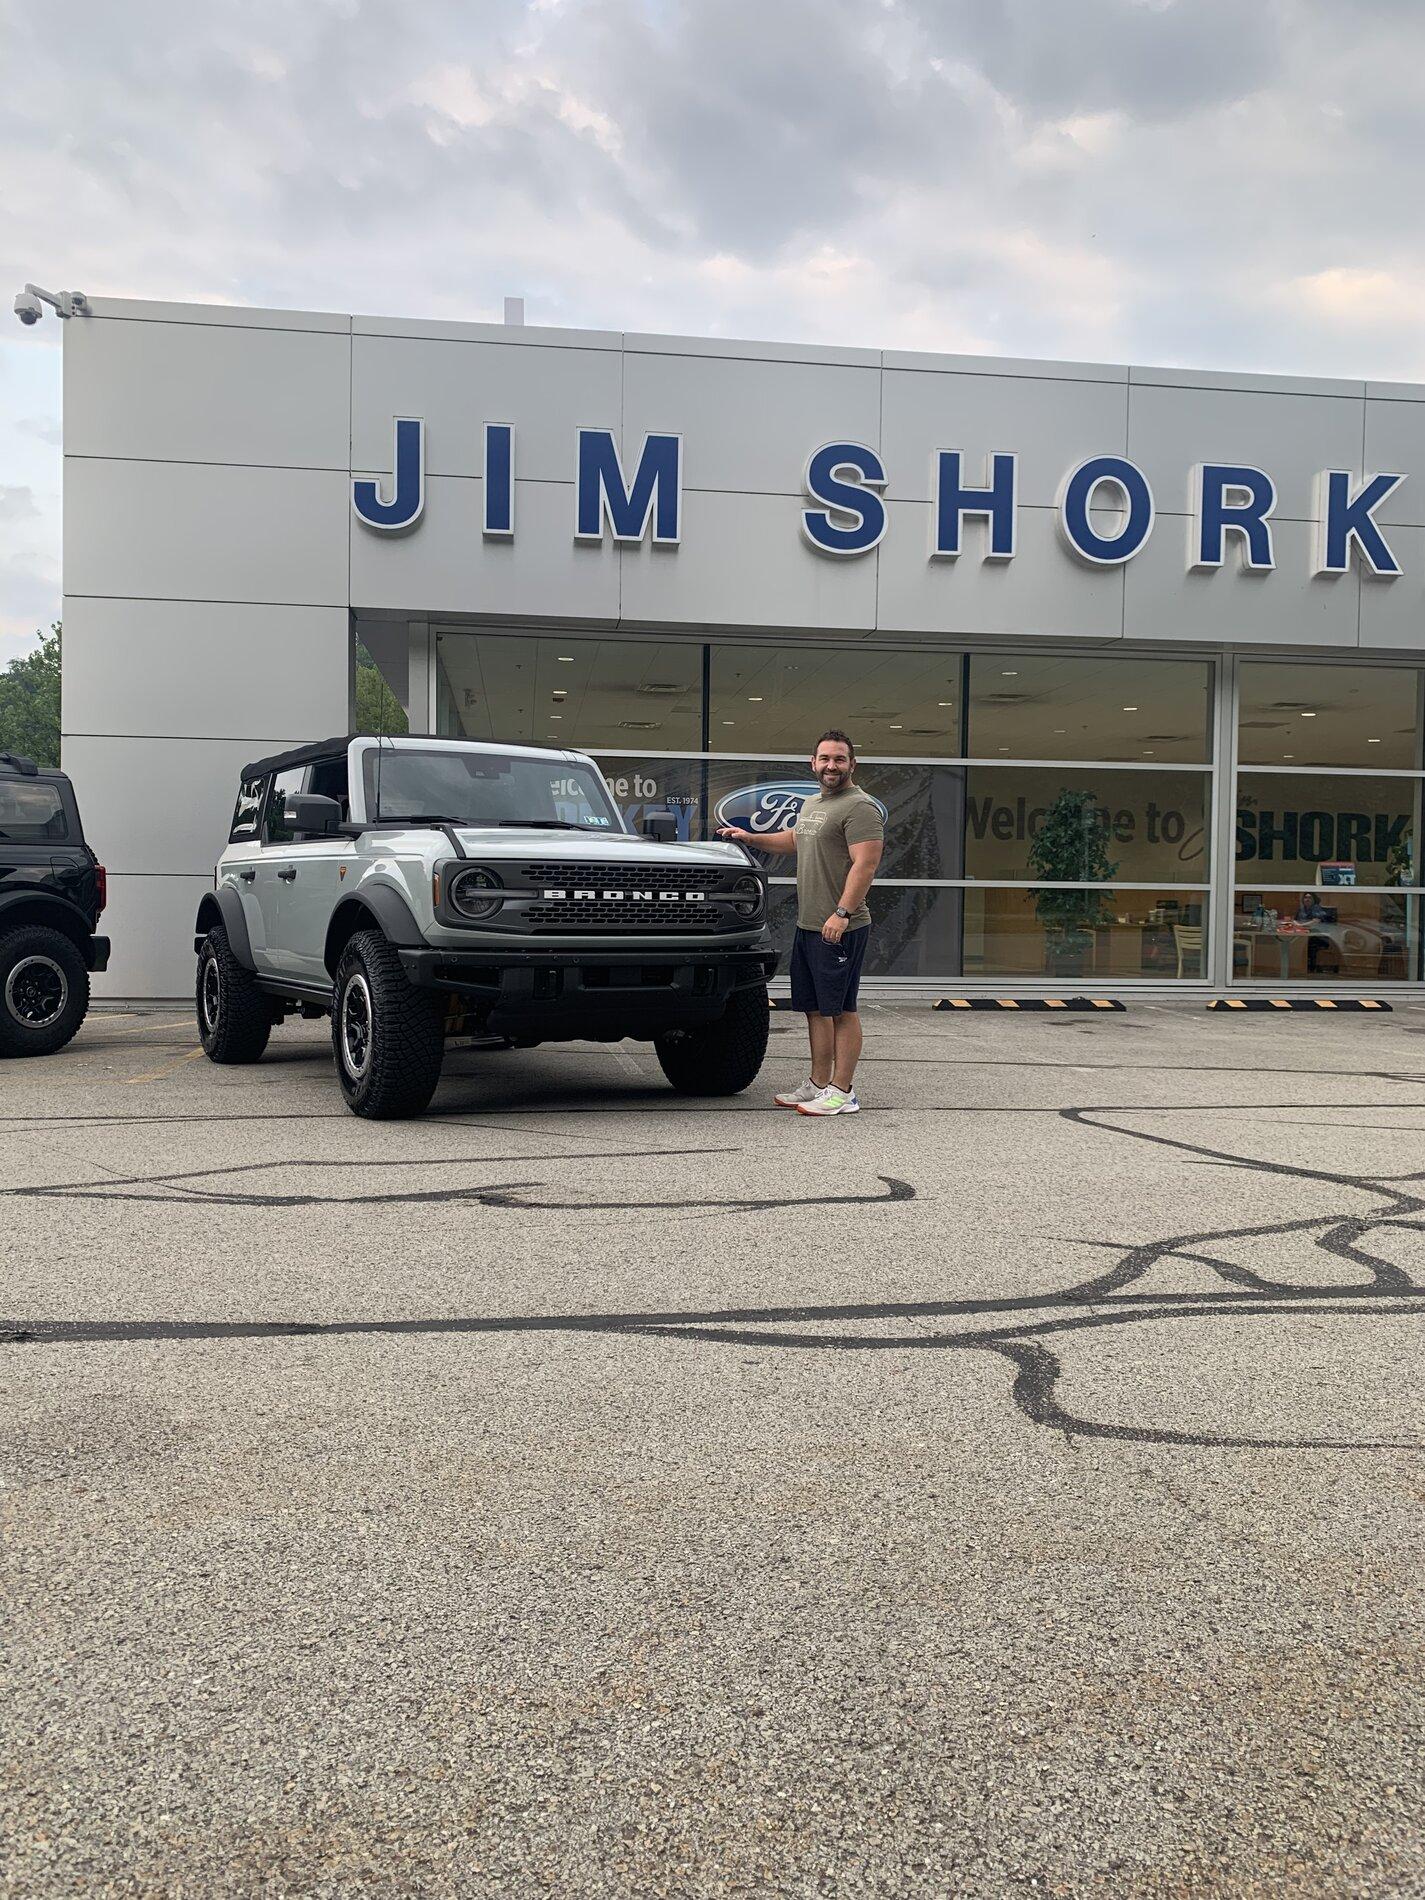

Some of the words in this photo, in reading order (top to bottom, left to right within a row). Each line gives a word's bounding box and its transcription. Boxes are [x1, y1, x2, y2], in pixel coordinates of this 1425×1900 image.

[351, 415, 684, 544] JIM
[801, 439, 1410, 577] SHORK
[634, 774, 657, 797] to
[666, 796, 681, 804] EST.
[965, 796, 1136, 843] Welce
[1146, 801, 1185, 844] to
[544, 889, 705, 901] BRONCO
